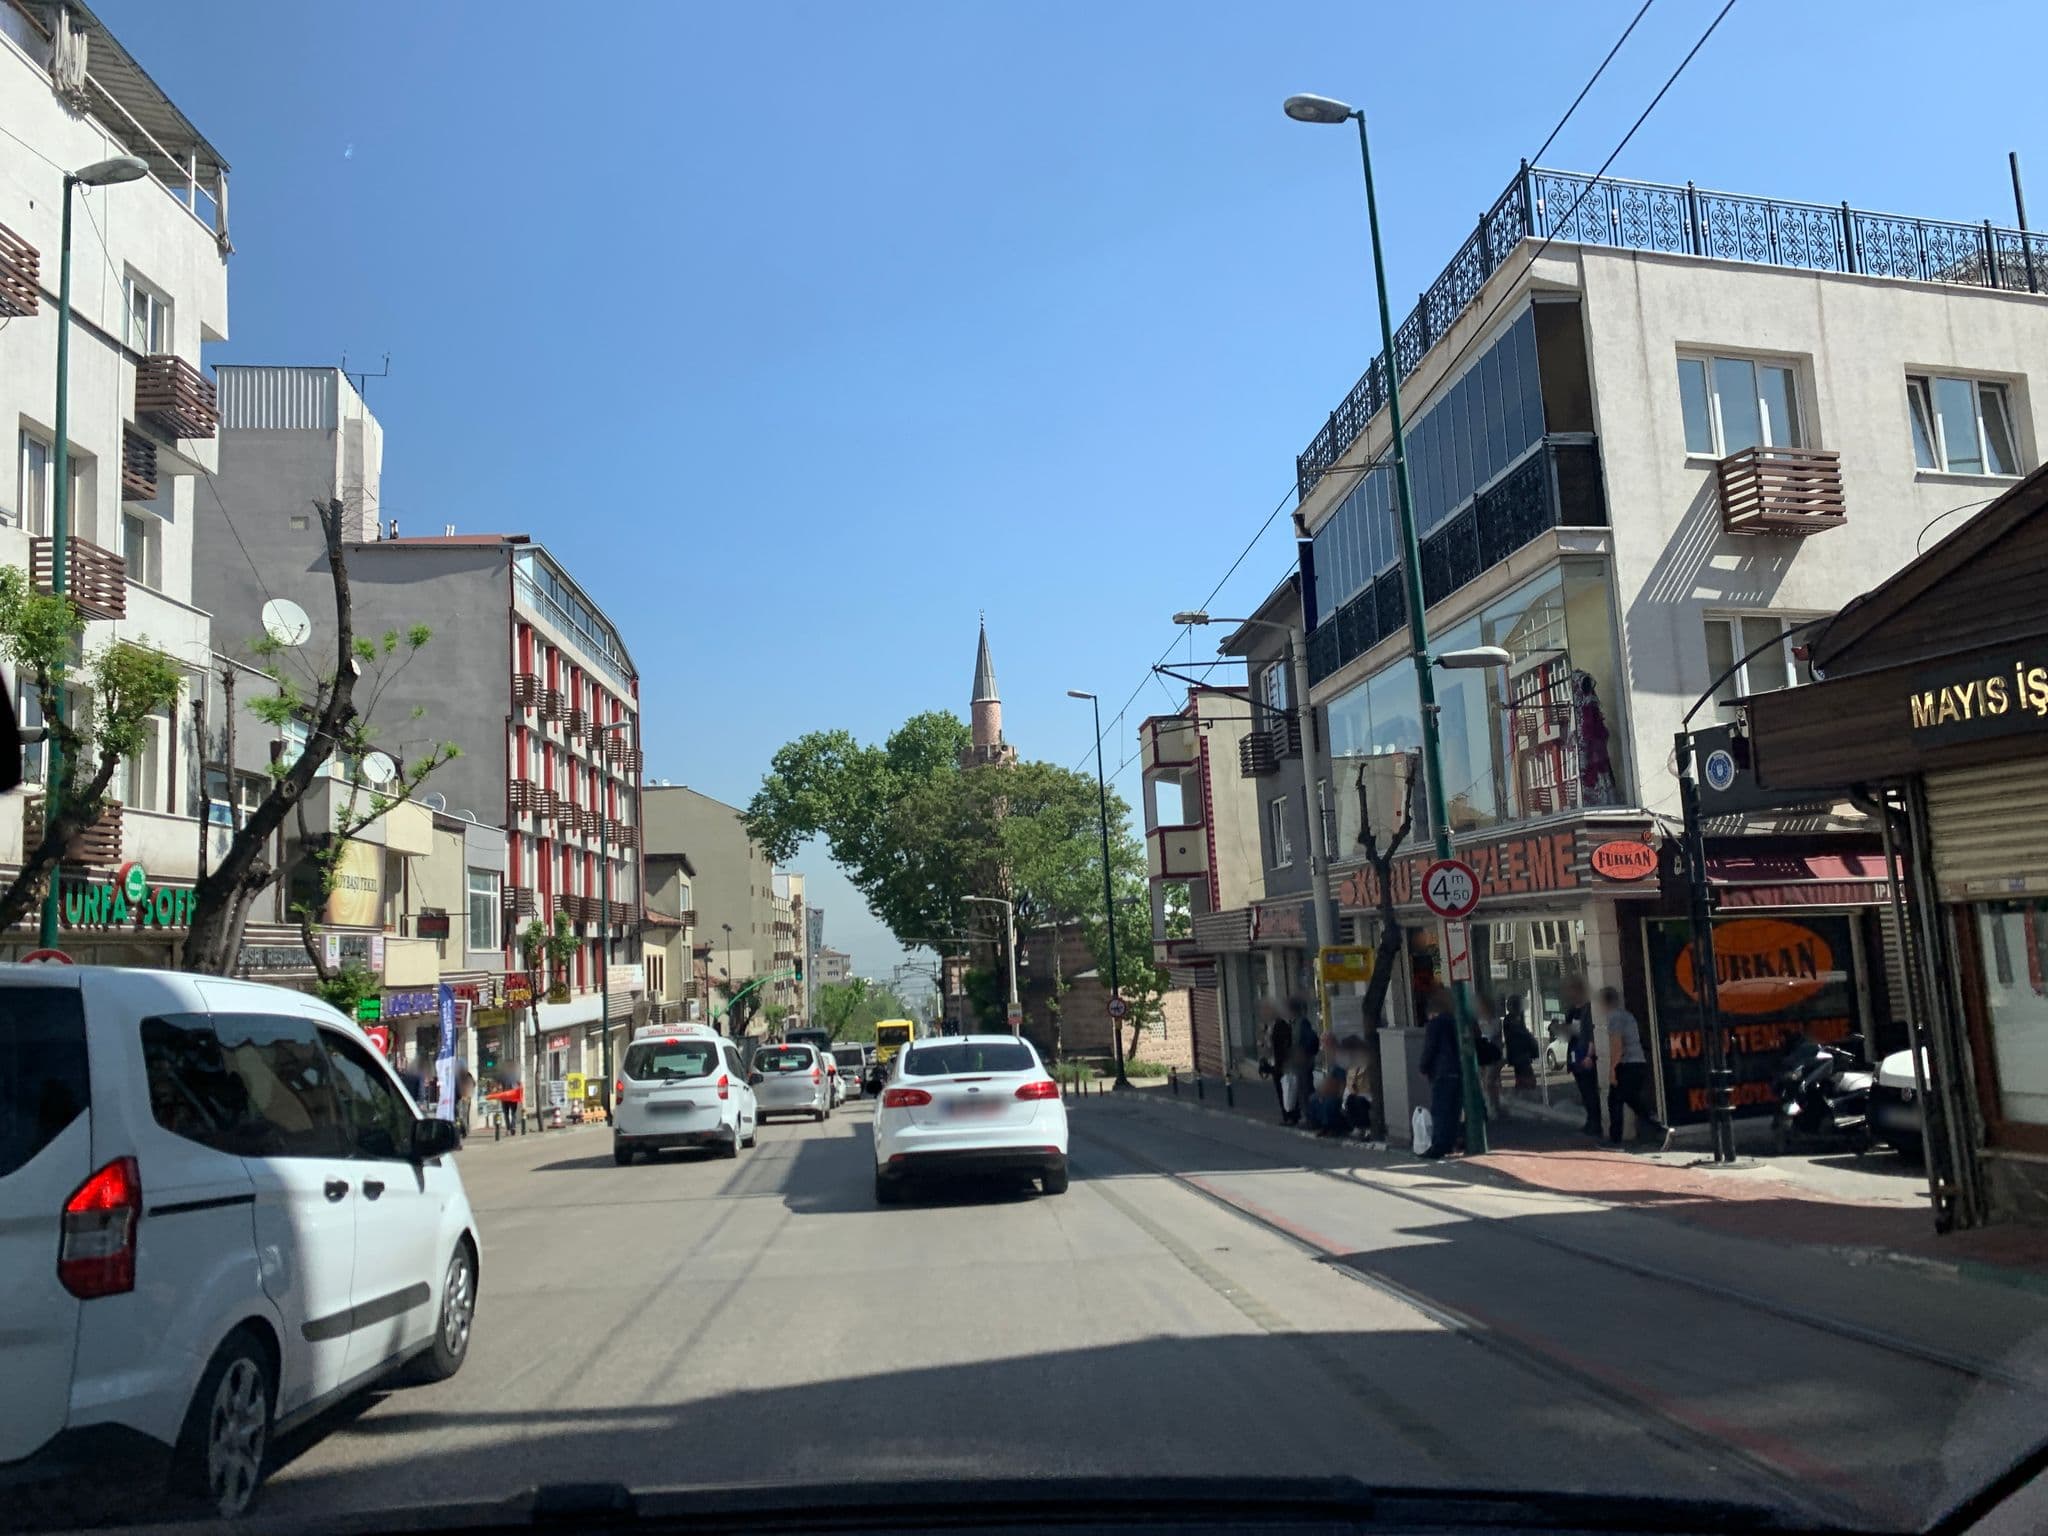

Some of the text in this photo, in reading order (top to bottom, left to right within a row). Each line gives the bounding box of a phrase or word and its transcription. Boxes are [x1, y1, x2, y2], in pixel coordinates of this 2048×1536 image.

[1911, 661, 2048, 728] MAYIS İŞ
[1598, 849, 1652, 868] FURKAN
[66, 882, 129, 924] URFA
[1432, 874, 1464, 902] 4 m
